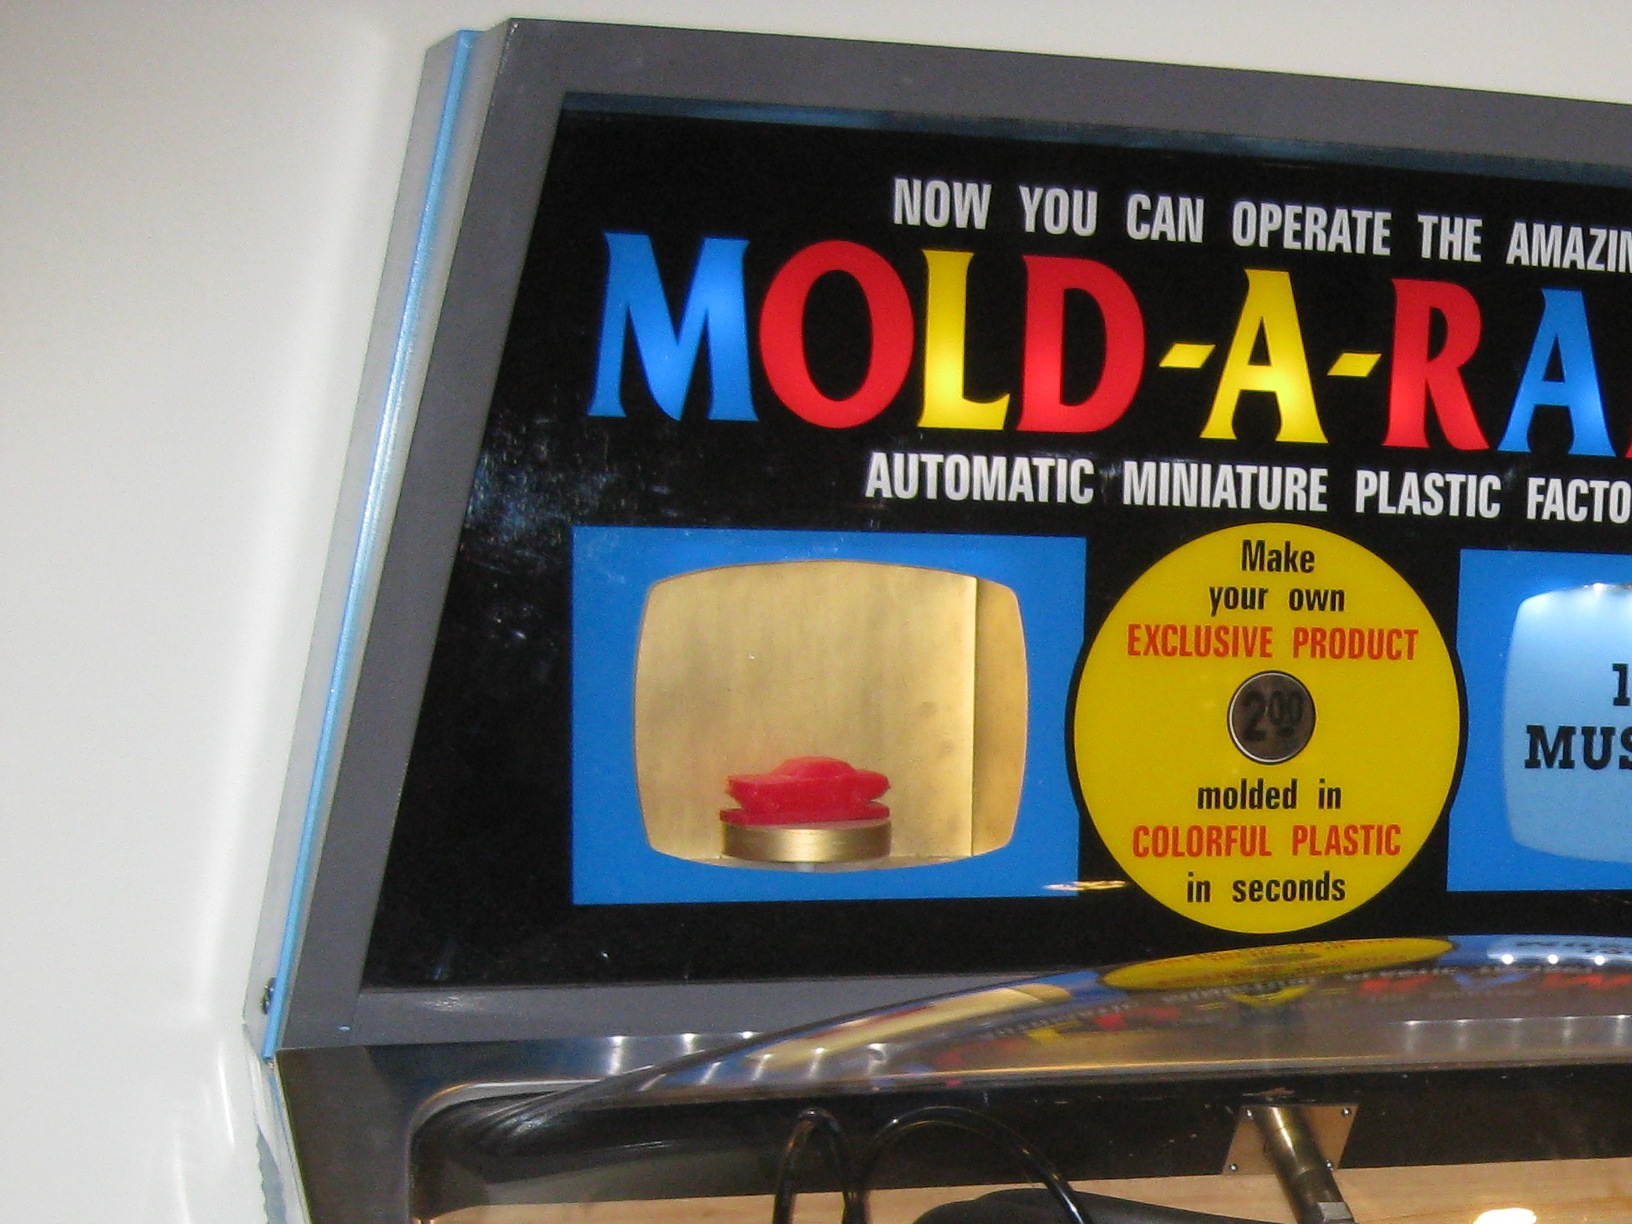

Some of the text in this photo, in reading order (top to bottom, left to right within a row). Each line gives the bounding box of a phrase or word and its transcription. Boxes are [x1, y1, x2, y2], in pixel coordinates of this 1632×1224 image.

[893, 177, 992, 230] NOW
[1019, 185, 1098, 237] YOU
[1126, 193, 1205, 243] CAN
[1232, 200, 1392, 256] OPERATE
[1417, 212, 1482, 262] THE
[865, 451, 1095, 505] AUTOMATIC
[1121, 460, 1329, 512] MINIATURE
[1355, 469, 1502, 518] PLASTIC
[1241, 539, 1316, 574] Make
[1209, 586, 1345, 617] your own
[1127, 623, 1419, 661] EXCLUSIVE PRODUCT
[1197, 778, 1342, 810] molded in
[1132, 824, 1402, 858] COLORFUL PLASTIC
[1187, 870, 1346, 902] in seconds
